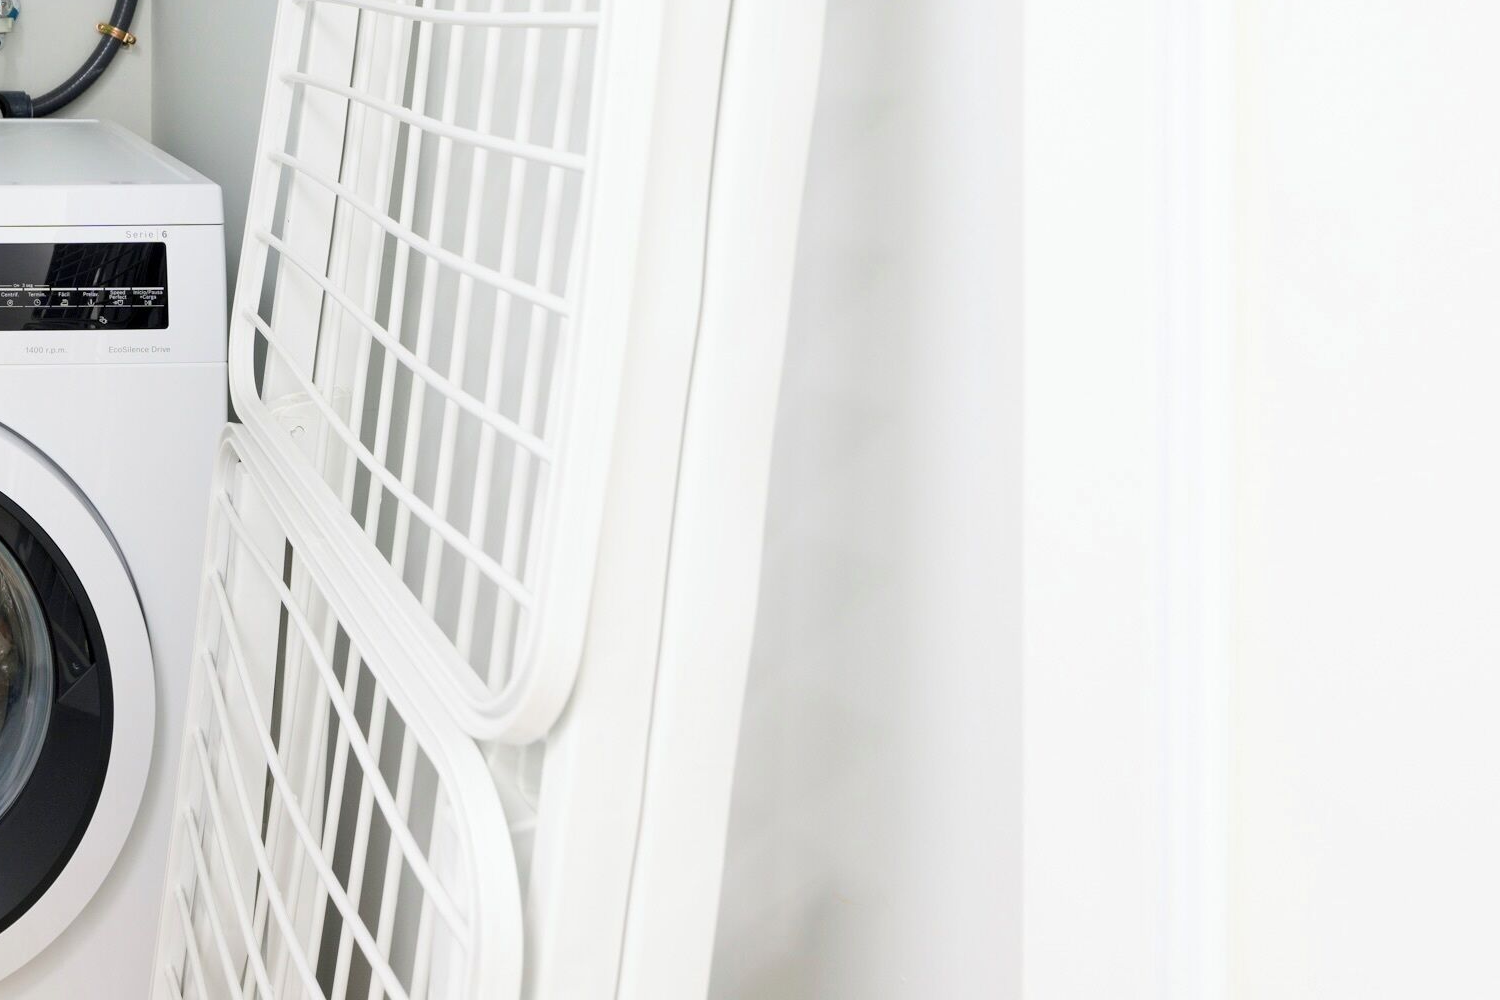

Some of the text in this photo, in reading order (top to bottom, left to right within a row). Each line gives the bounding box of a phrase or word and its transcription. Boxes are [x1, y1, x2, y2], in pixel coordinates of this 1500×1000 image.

[125, 230, 168, 239] Serie 6
[25, 346, 44, 354] 1400
[108, 345, 171, 353] EcoSilence Drive
